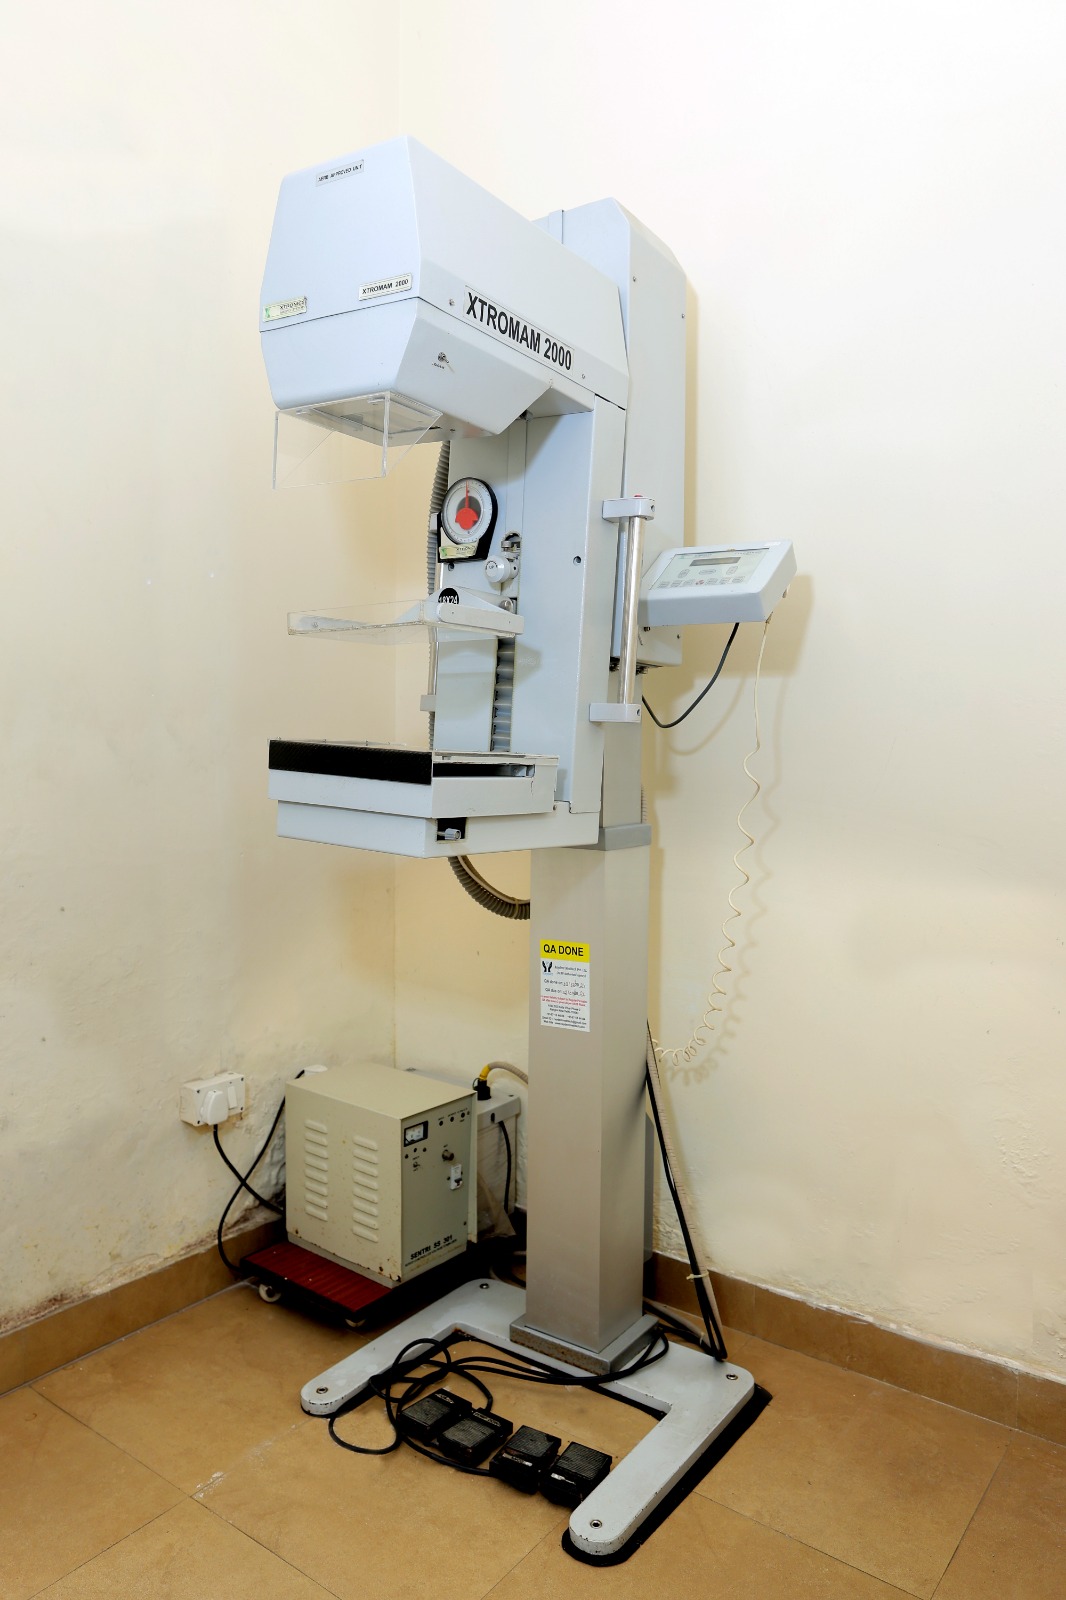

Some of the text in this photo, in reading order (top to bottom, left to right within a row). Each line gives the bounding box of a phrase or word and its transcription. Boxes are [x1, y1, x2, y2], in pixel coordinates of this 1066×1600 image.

[361, 282, 393, 295] XTROMAM
[466, 291, 572, 371] XTROMAM 2000
[543, 943, 584, 957] QA DONE
[410, 1245, 431, 1260] SENTRI
